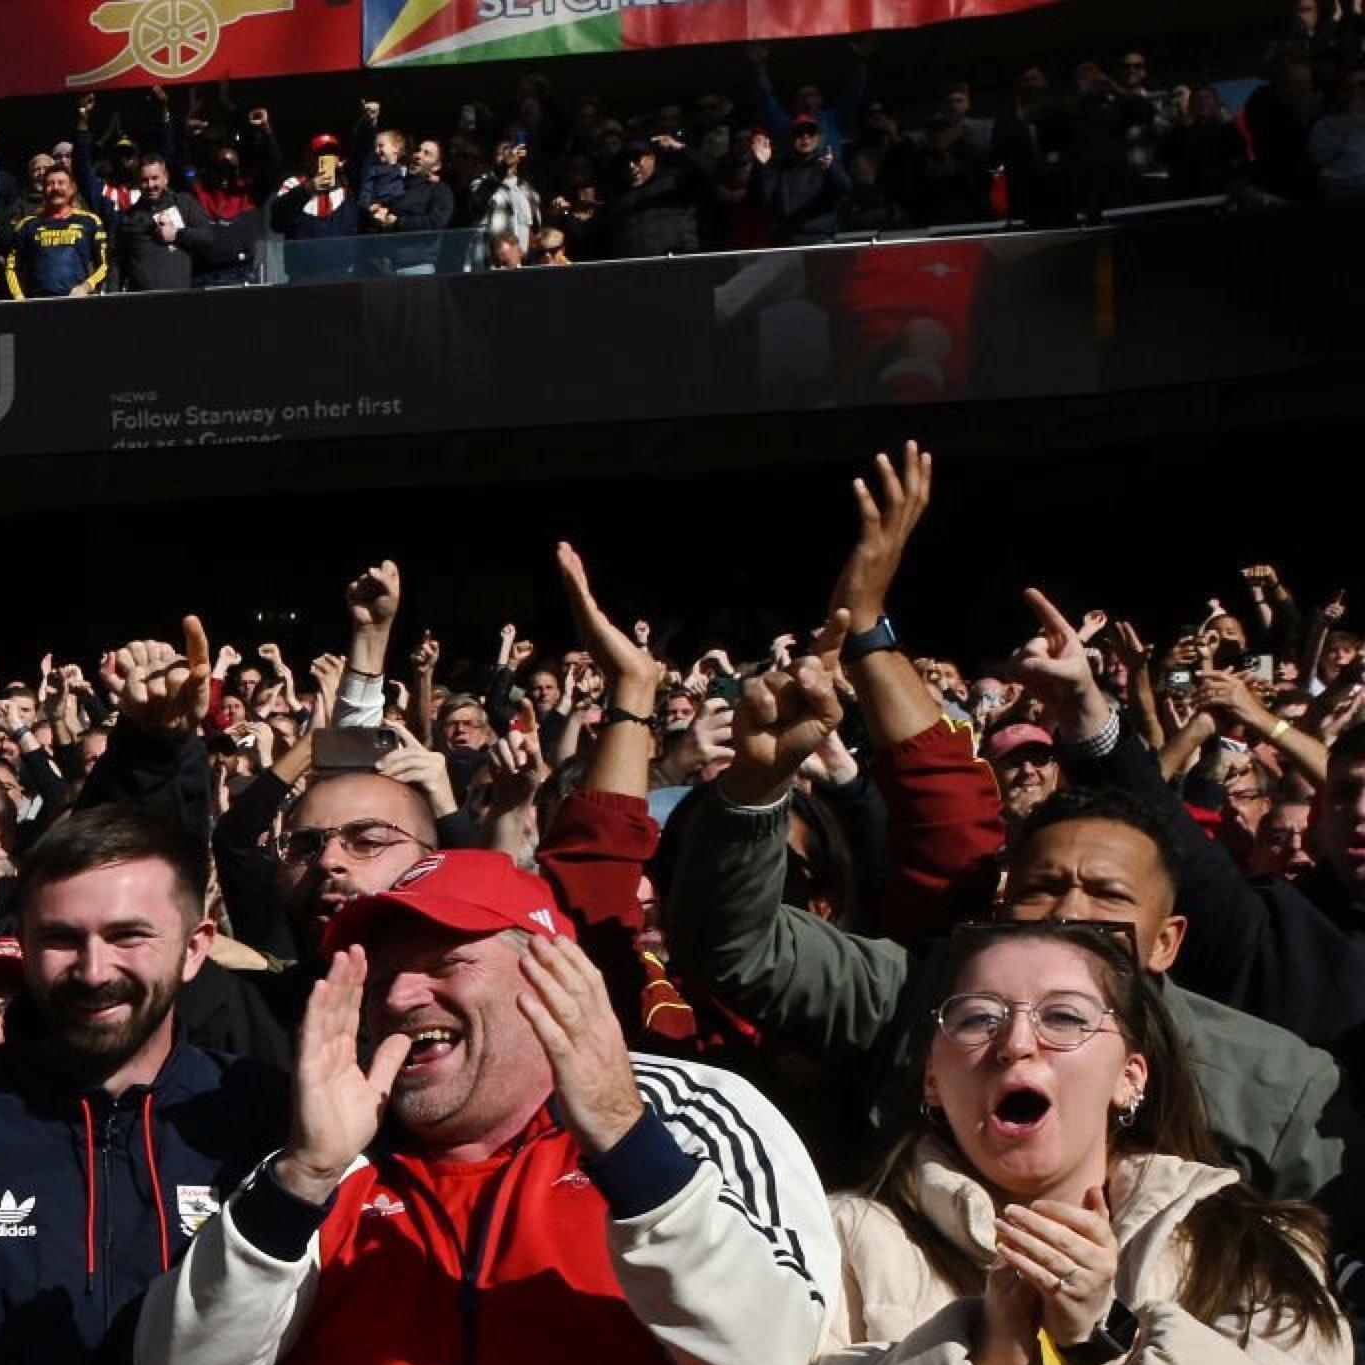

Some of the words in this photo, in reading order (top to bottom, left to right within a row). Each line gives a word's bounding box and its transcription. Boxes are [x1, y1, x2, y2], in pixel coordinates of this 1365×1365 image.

[112, 409, 180, 430] Follow
[186, 404, 275, 427] Stanway
[282, 402, 309, 419] on
[315, 398, 351, 418] her
[358, 396, 403, 416] first
